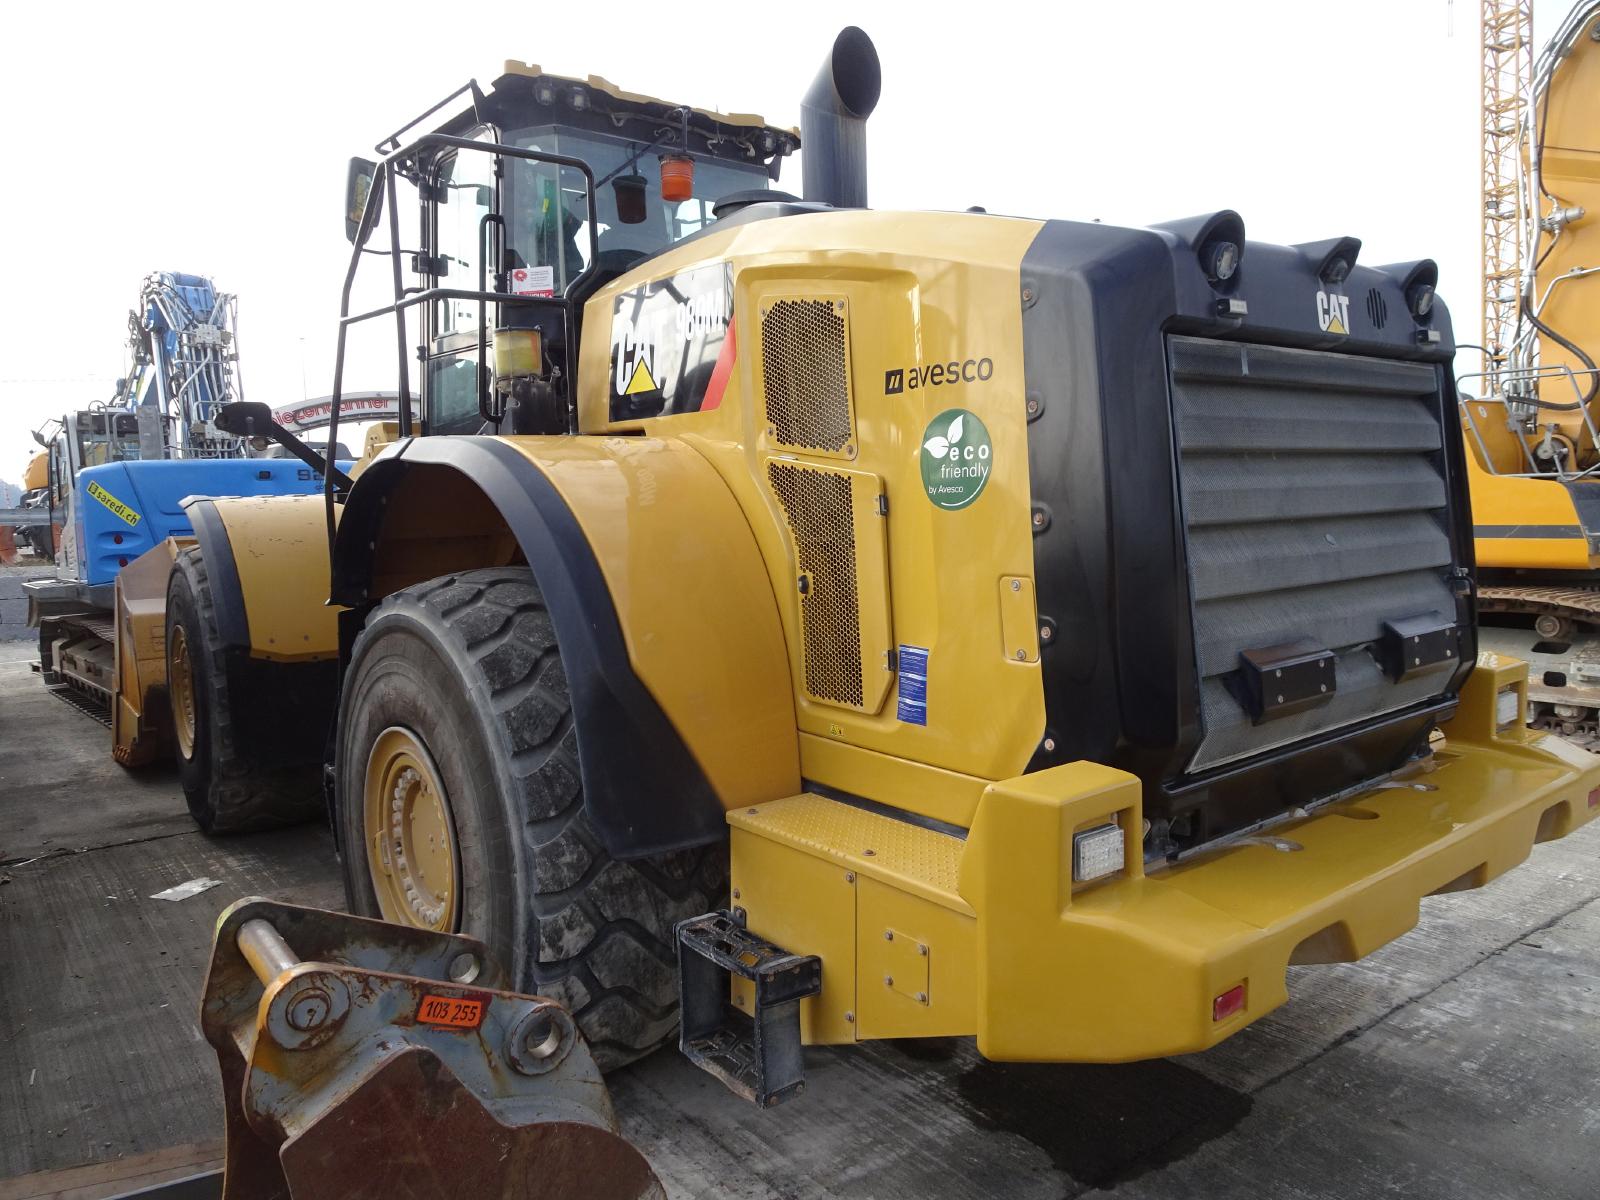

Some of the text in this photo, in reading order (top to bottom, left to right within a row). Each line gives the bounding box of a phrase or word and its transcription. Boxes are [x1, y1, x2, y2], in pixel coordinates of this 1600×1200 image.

[676, 288, 724, 342] 980M
[1316, 290, 1350, 335] CAT
[616, 310, 668, 396] CAT
[908, 357, 994, 390] avesco
[272, 399, 390, 425] iezenanner
[949, 444, 990, 462] eco
[940, 462, 990, 480] friendly
[928, 484, 964, 496] by Avesco
[96, 490, 138, 525] saredi.ch
[425, 1000, 479, 1023] 103 255
